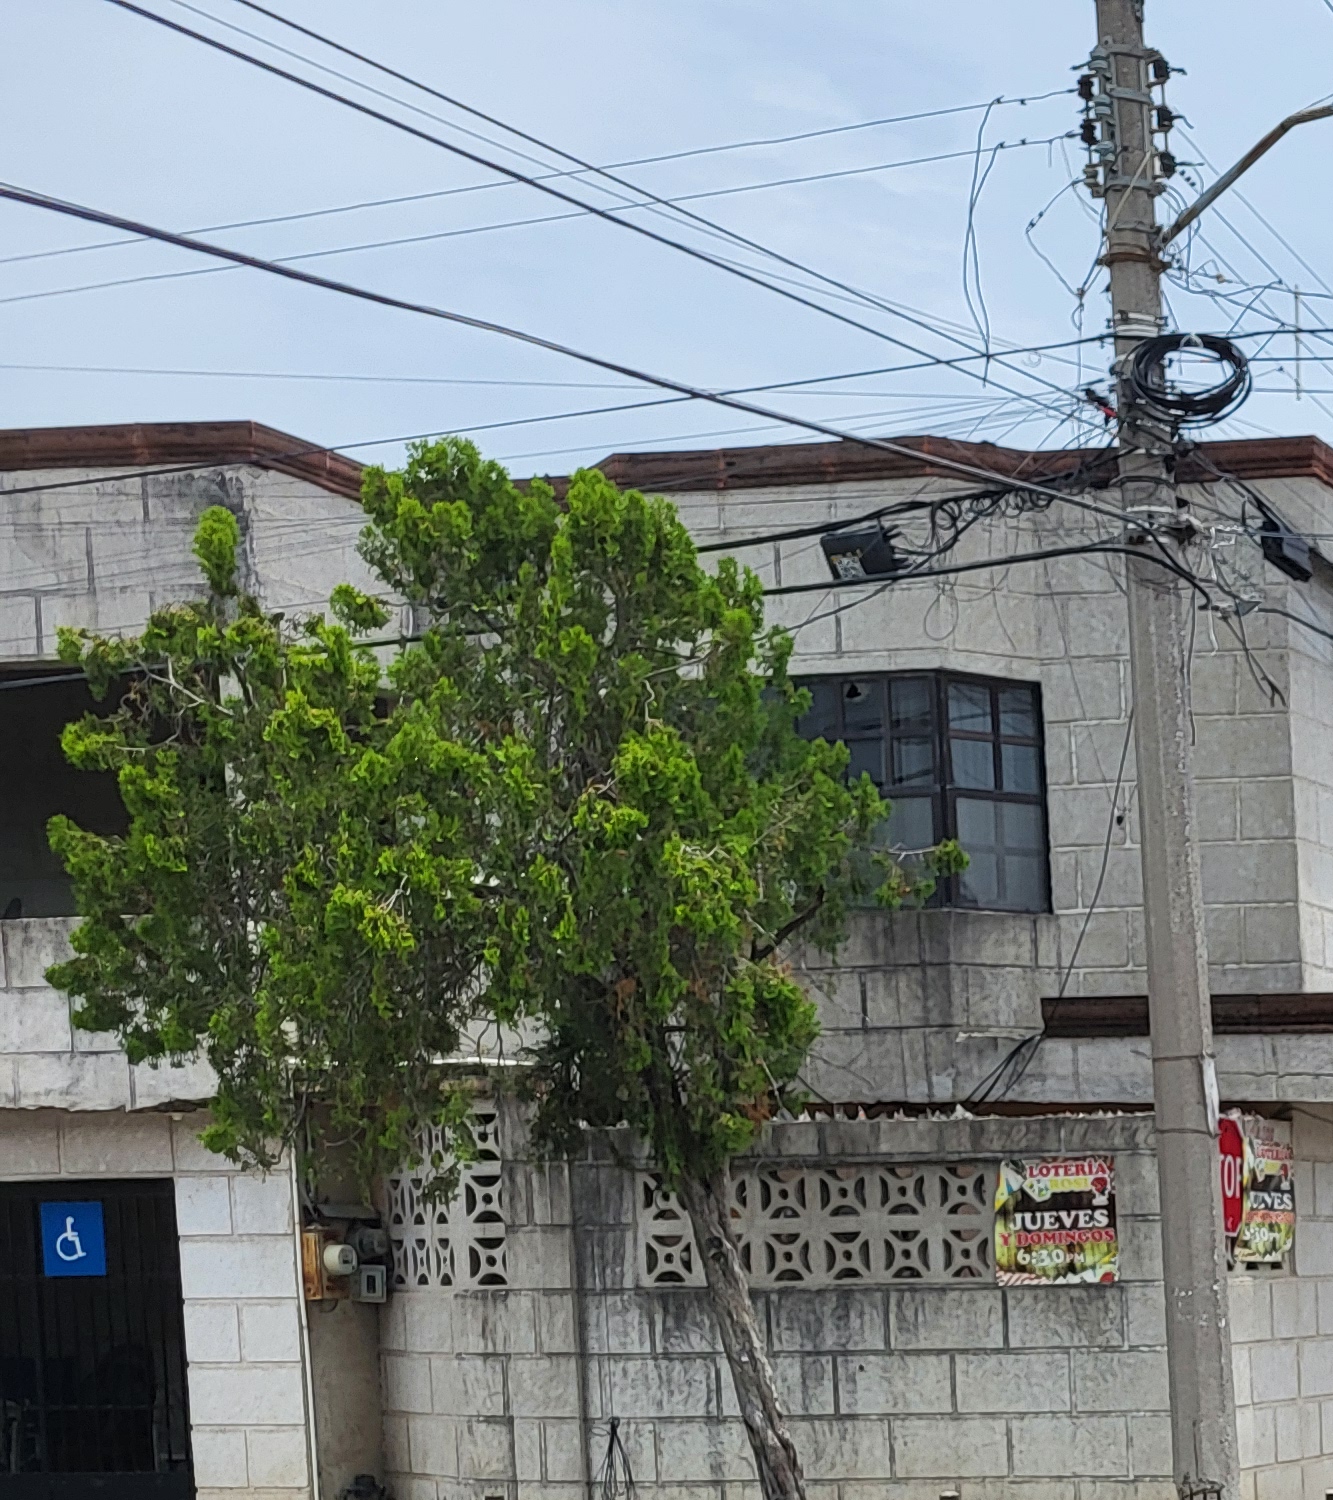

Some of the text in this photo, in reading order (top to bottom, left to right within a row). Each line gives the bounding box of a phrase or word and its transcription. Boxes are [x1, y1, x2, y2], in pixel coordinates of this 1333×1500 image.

[1028, 1159, 1108, 1178] LOTERÍA
[1010, 1208, 1110, 1231] JUEVES
[1000, 1228, 1115, 1246] Y DOMINGOS
